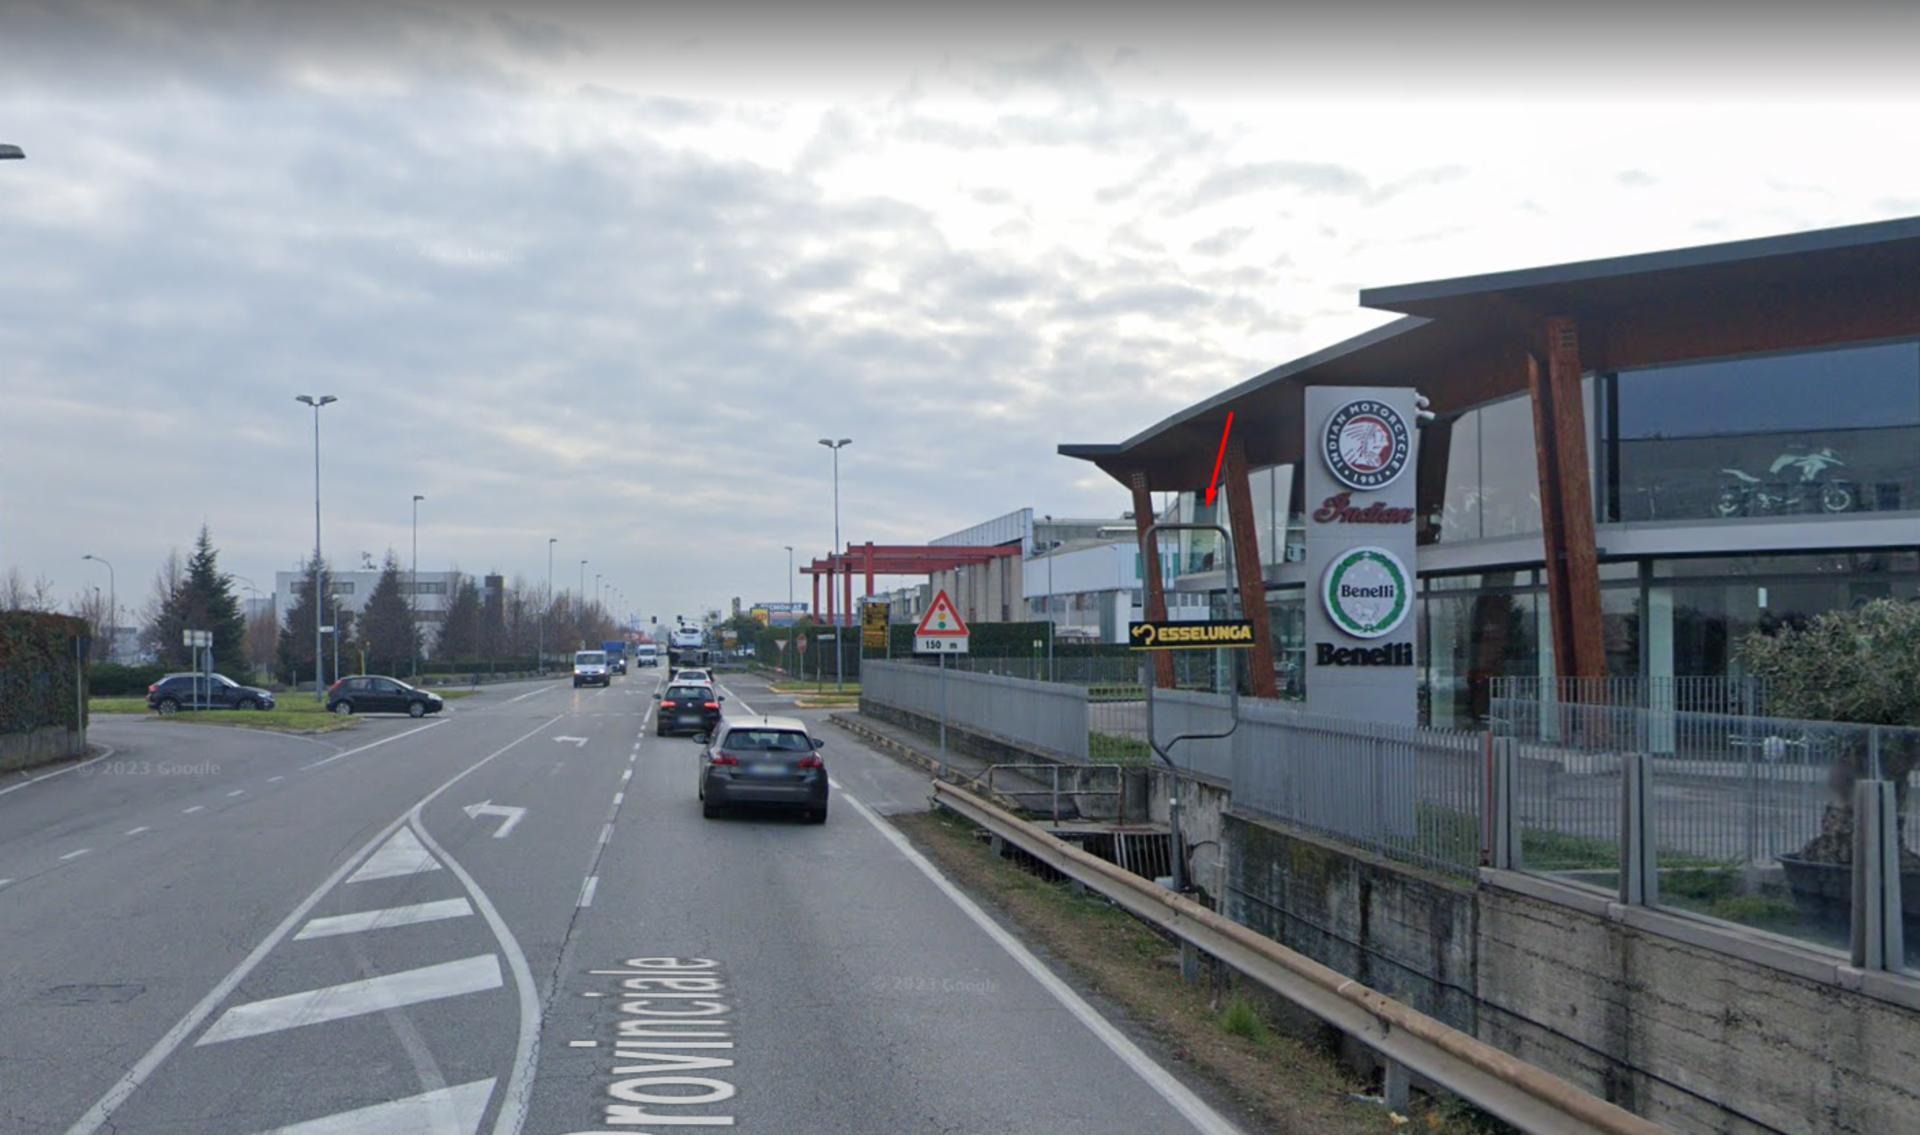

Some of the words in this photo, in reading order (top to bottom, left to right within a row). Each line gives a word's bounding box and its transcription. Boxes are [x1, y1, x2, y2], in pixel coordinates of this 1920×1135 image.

[1329, 414, 1346, 469] INDIAN
[1349, 403, 1406, 470] MOTORCYCLE
[1353, 473, 1382, 484] 1901
[1313, 492, 1415, 523] Indian
[1341, 584, 1394, 598] Benelli
[1158, 625, 1252, 641] ESSELUNGA
[925, 640, 942, 649] 150
[1316, 642, 1413, 666] Benelli
[562, 957, 736, 1135] rovinciale
